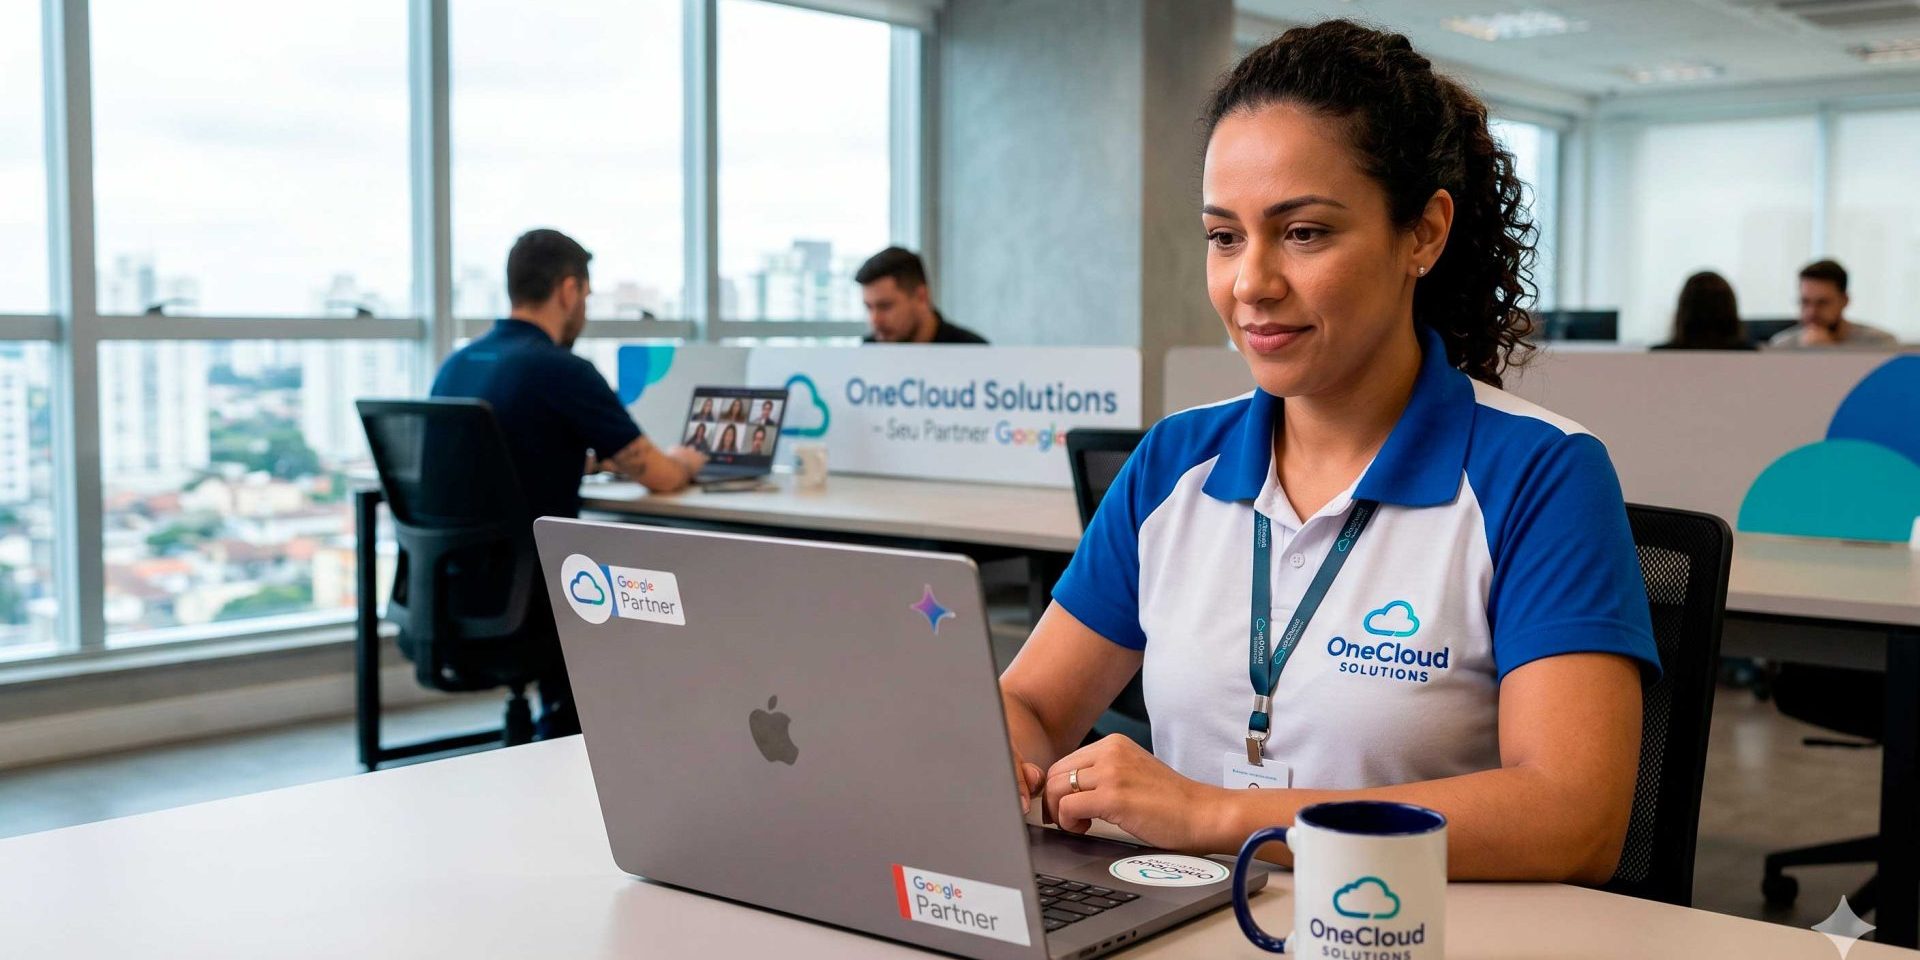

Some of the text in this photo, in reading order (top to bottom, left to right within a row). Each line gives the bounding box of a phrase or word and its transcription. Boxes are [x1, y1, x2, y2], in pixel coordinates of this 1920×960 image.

[846, 377, 1117, 414] OneCloud Solutions
[886, 417, 919, 440] Seu
[923, 418, 989, 445] Partner
[617, 575, 654, 593] Google
[621, 591, 676, 615] Partner
[1327, 636, 1449, 669] OneCloud
[1339, 662, 1428, 683] SOLUTIONS
[913, 875, 962, 900] Google
[916, 894, 998, 931] Partner
[1310, 918, 1425, 947] OneCloud
[1322, 945, 1411, 960] SOLUTIONS
